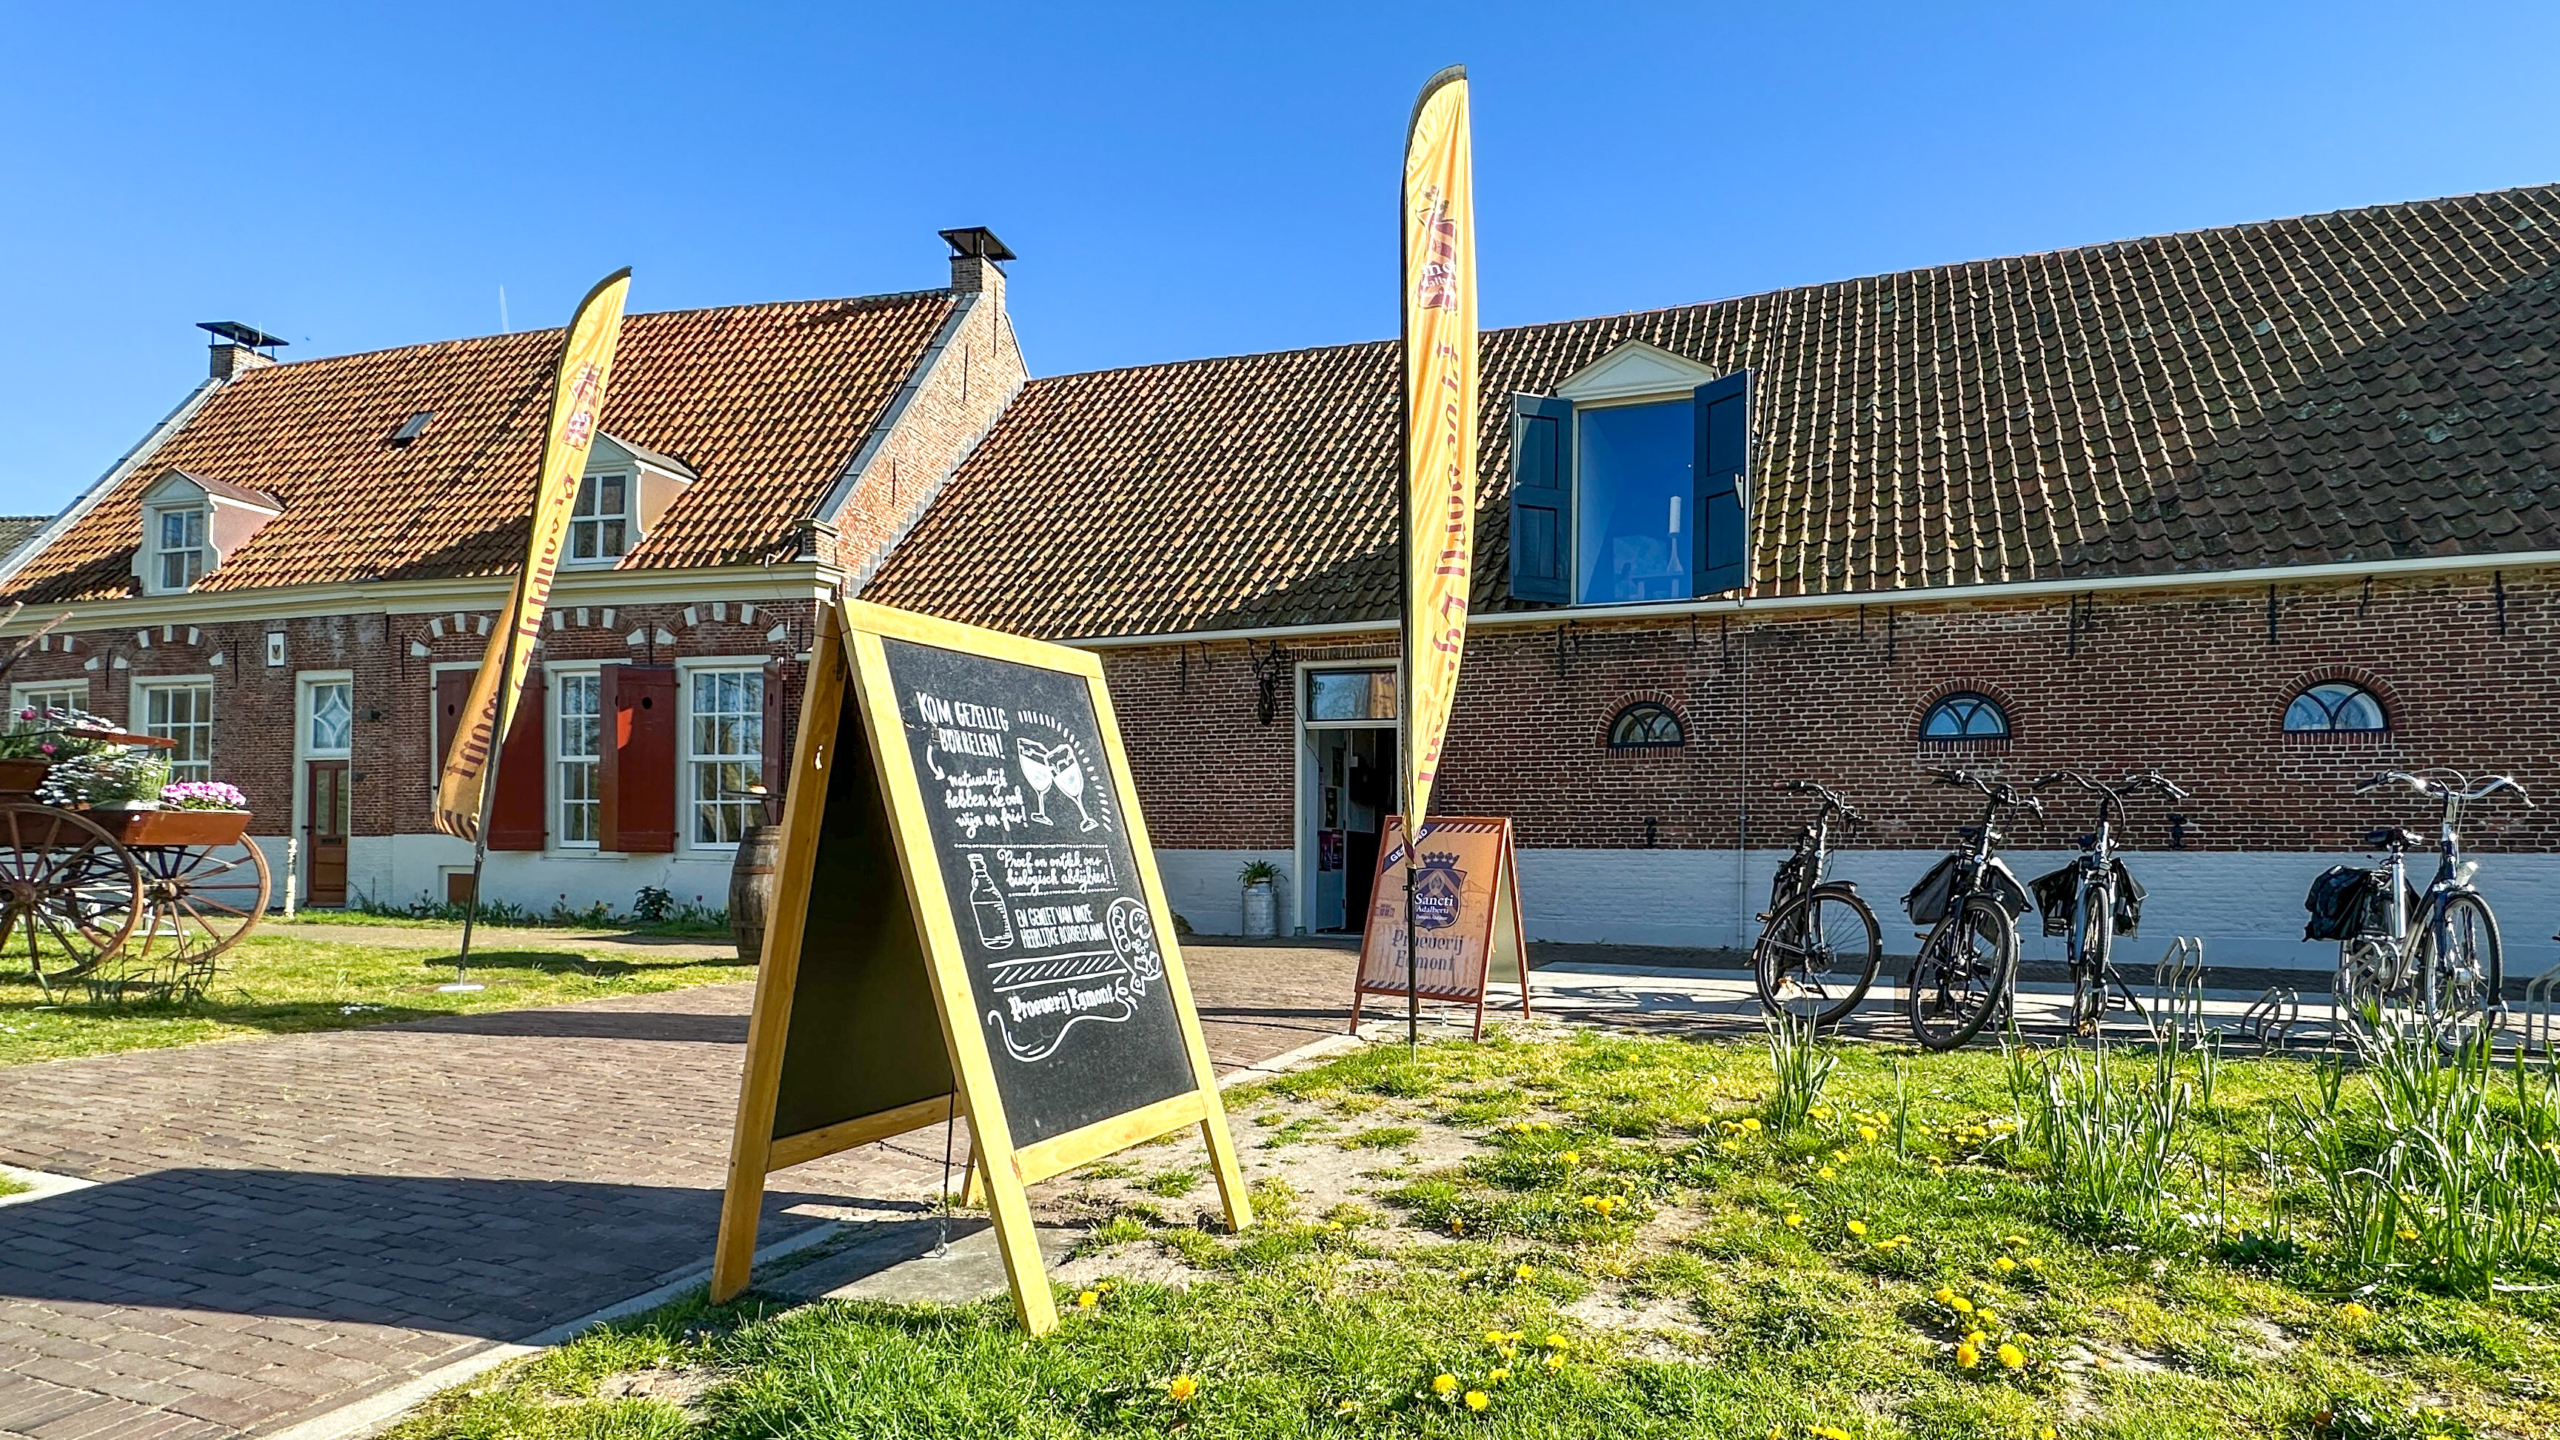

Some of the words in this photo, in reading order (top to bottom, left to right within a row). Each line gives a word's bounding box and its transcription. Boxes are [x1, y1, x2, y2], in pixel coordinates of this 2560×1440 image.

[916, 691, 953, 725] KOM
[954, 701, 1009, 732] GEZELLIG
[938, 727, 1005, 759] BORRELEN!
[947, 767, 1008, 797] natuurlijk
[945, 788, 988, 809] hebben
[988, 795, 1006, 808] we
[1005, 785, 1023, 805] ook
[955, 812, 983, 839] wijn
[985, 813, 1001, 827] en
[1001, 805, 1028, 832] fris!
[997, 849, 1033, 874] Proef
[1034, 858, 1047, 867] en
[1083, 857, 1103, 867] ons
[1006, 867, 1059, 896] biologisch
[1061, 864, 1111, 894] abdijbier!
[1414, 893, 1454, 907] Sancti
[1014, 909, 1029, 928] EN
[1027, 907, 1057, 926] GENIET
[1055, 905, 1073, 924] VAN
[1072, 903, 1094, 923] ONZE
[1020, 927, 1060, 949] HEERLIJKE
[1058, 922, 1108, 945] BORRELPLANK
[1395, 949, 1454, 971] Emont
[1008, 990, 1071, 1023] Proeverij
[1068, 984, 1116, 1011] Egmont
